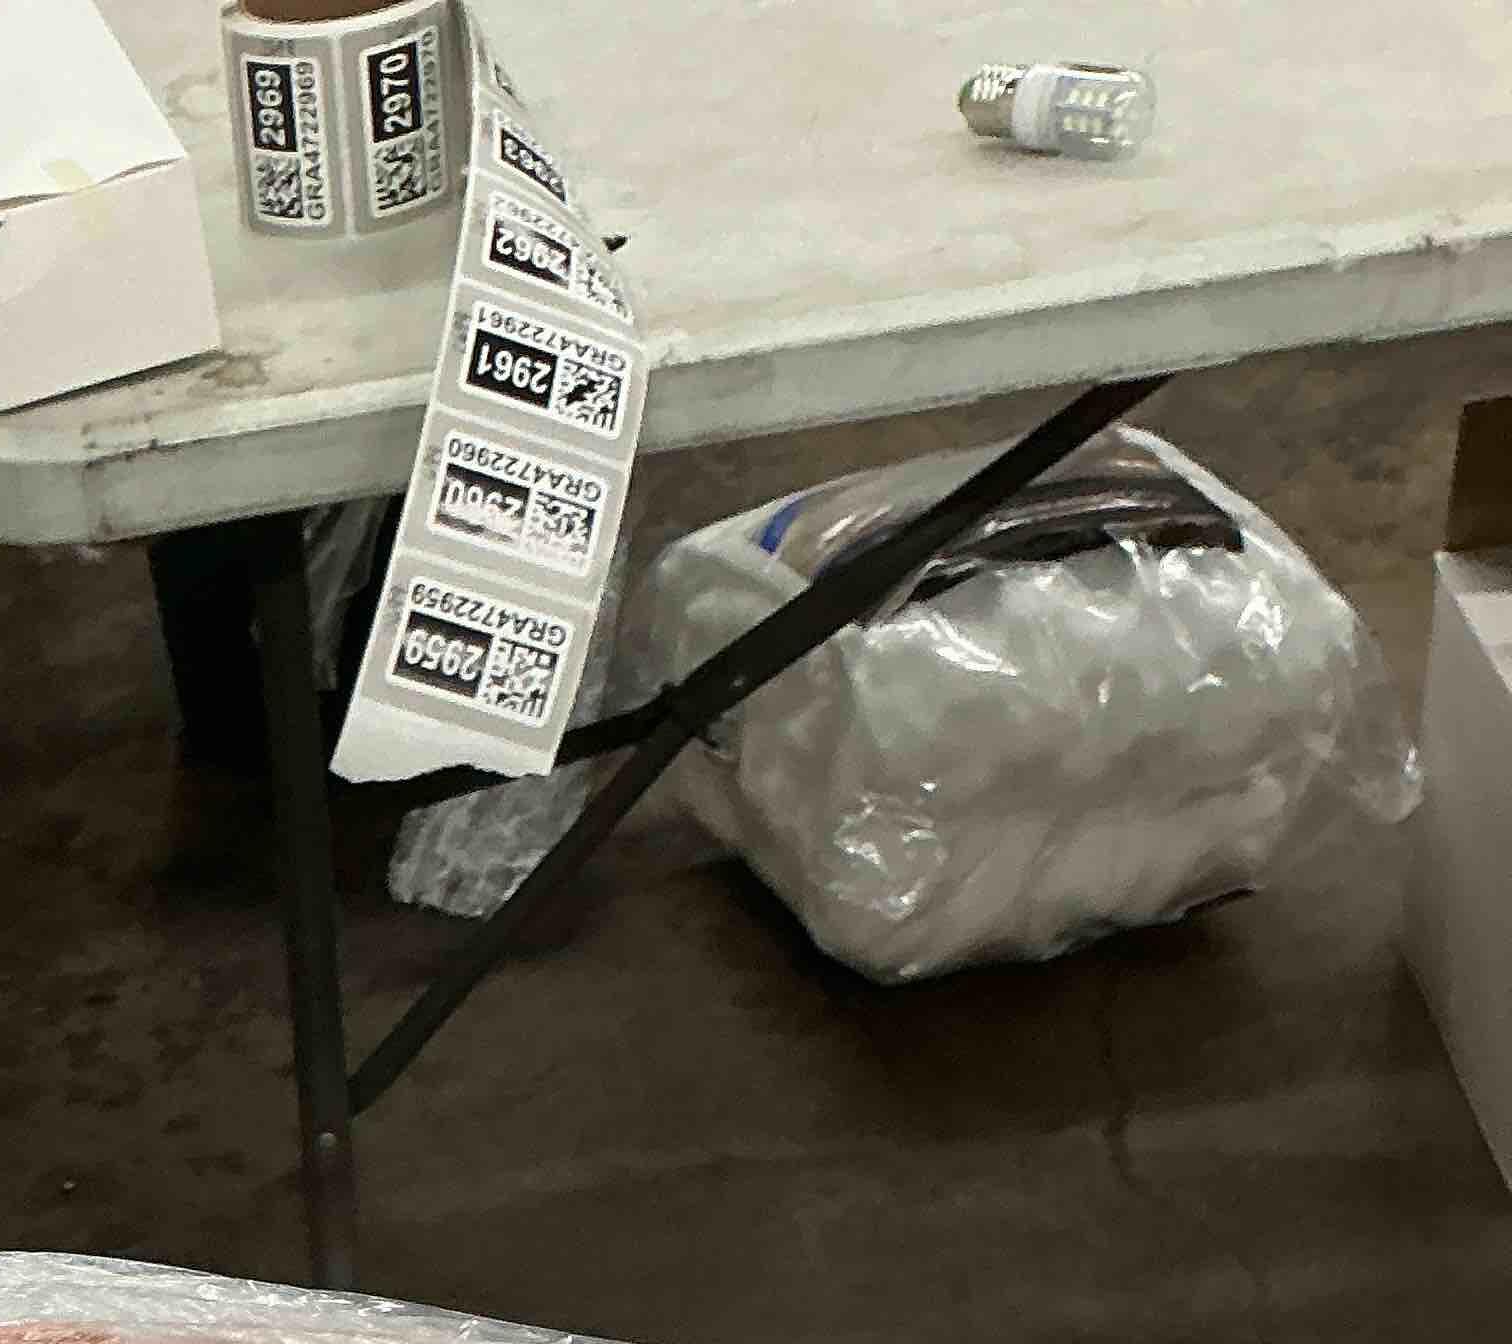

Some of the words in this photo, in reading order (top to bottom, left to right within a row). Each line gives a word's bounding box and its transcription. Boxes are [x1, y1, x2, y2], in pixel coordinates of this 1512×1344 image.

[255, 67, 287, 149] 2969
[380, 51, 414, 134] 2970
[476, 306, 626, 372] GRA4722961
[476, 343, 555, 395] 2961
[447, 437, 603, 500] GRA4722960
[412, 583, 568, 647] GRA4722959
[403, 629, 489, 683] 2959
